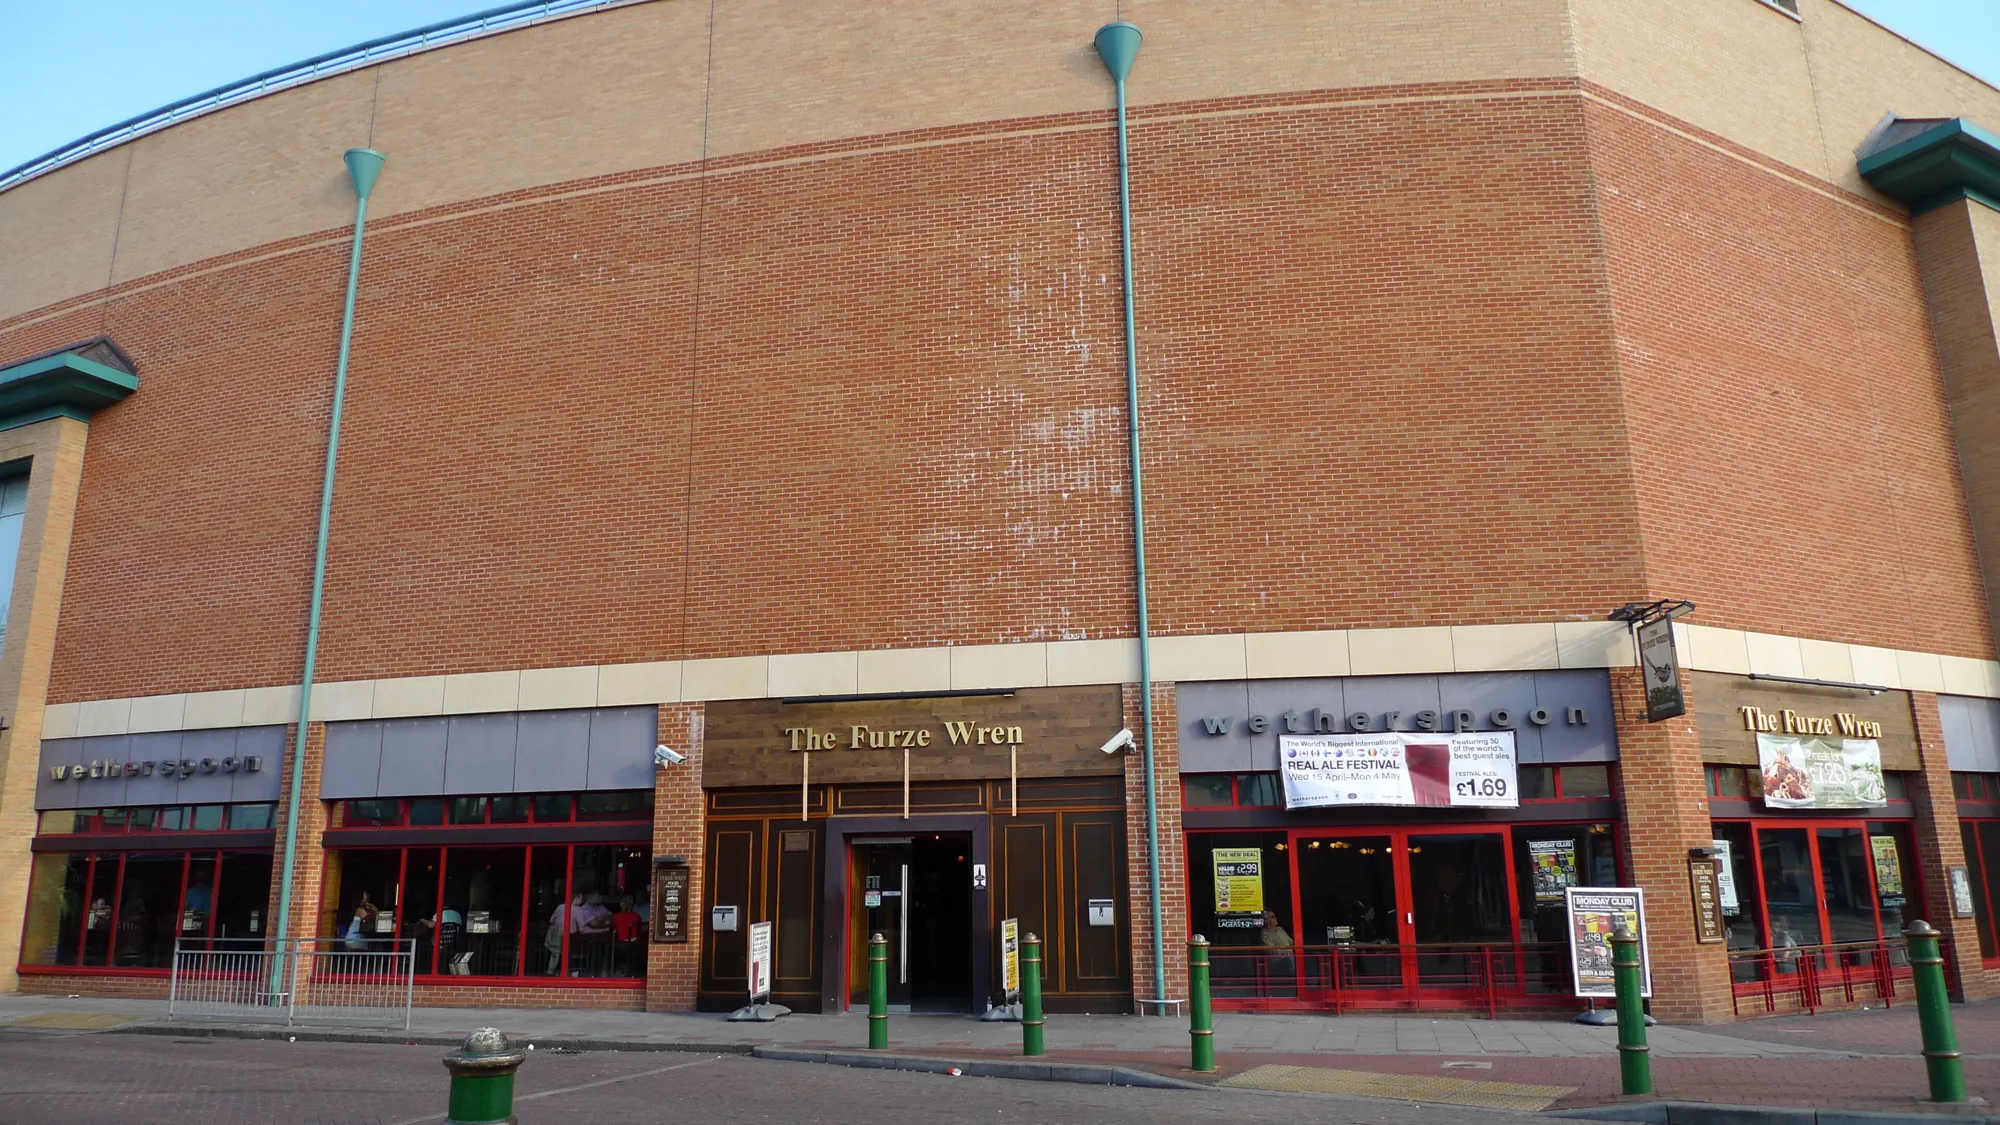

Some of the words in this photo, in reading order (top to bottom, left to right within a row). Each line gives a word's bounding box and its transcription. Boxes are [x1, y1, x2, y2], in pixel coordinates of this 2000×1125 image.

[1201, 704, 1589, 735] wetherspoon
[1741, 705, 1778, 731] The
[1780, 708, 1833, 735] Furze
[1834, 712, 1883, 738] Wren
[785, 727, 837, 751] The
[850, 725, 932, 749] Furze
[944, 720, 1024, 745] Wren
[1327, 740, 1354, 748] Biggest
[1355, 738, 1399, 747] International
[1451, 738, 1488, 746] Featuring
[1489, 737, 1499, 745] 50
[1476, 744, 1504, 752] world's
[1453, 752, 1471, 760] best
[1472, 753, 1494, 761] guest
[1495, 752, 1510, 760] ales
[1804, 750, 1812, 760] 2
[50, 755, 263, 781] wetherspoon
[1287, 760, 1319, 770] REAL
[1321, 760, 1344, 770] ALE
[1346, 759, 1400, 770] FESTIVAL
[1288, 773, 1309, 781] Wed
[1312, 773, 1323, 781] 15
[1373, 772, 1380, 780] 4
[1381, 771, 1401, 782] May
[1810, 762, 1846, 785] £7.20
[1456, 777, 1507, 797] £1.69
[1292, 794, 1329, 802] wetherspoon
[1237, 863, 1258, 874] £2.99
[1576, 897, 1610, 905] MONDAY
[1611, 898, 1633, 906] CLUB
